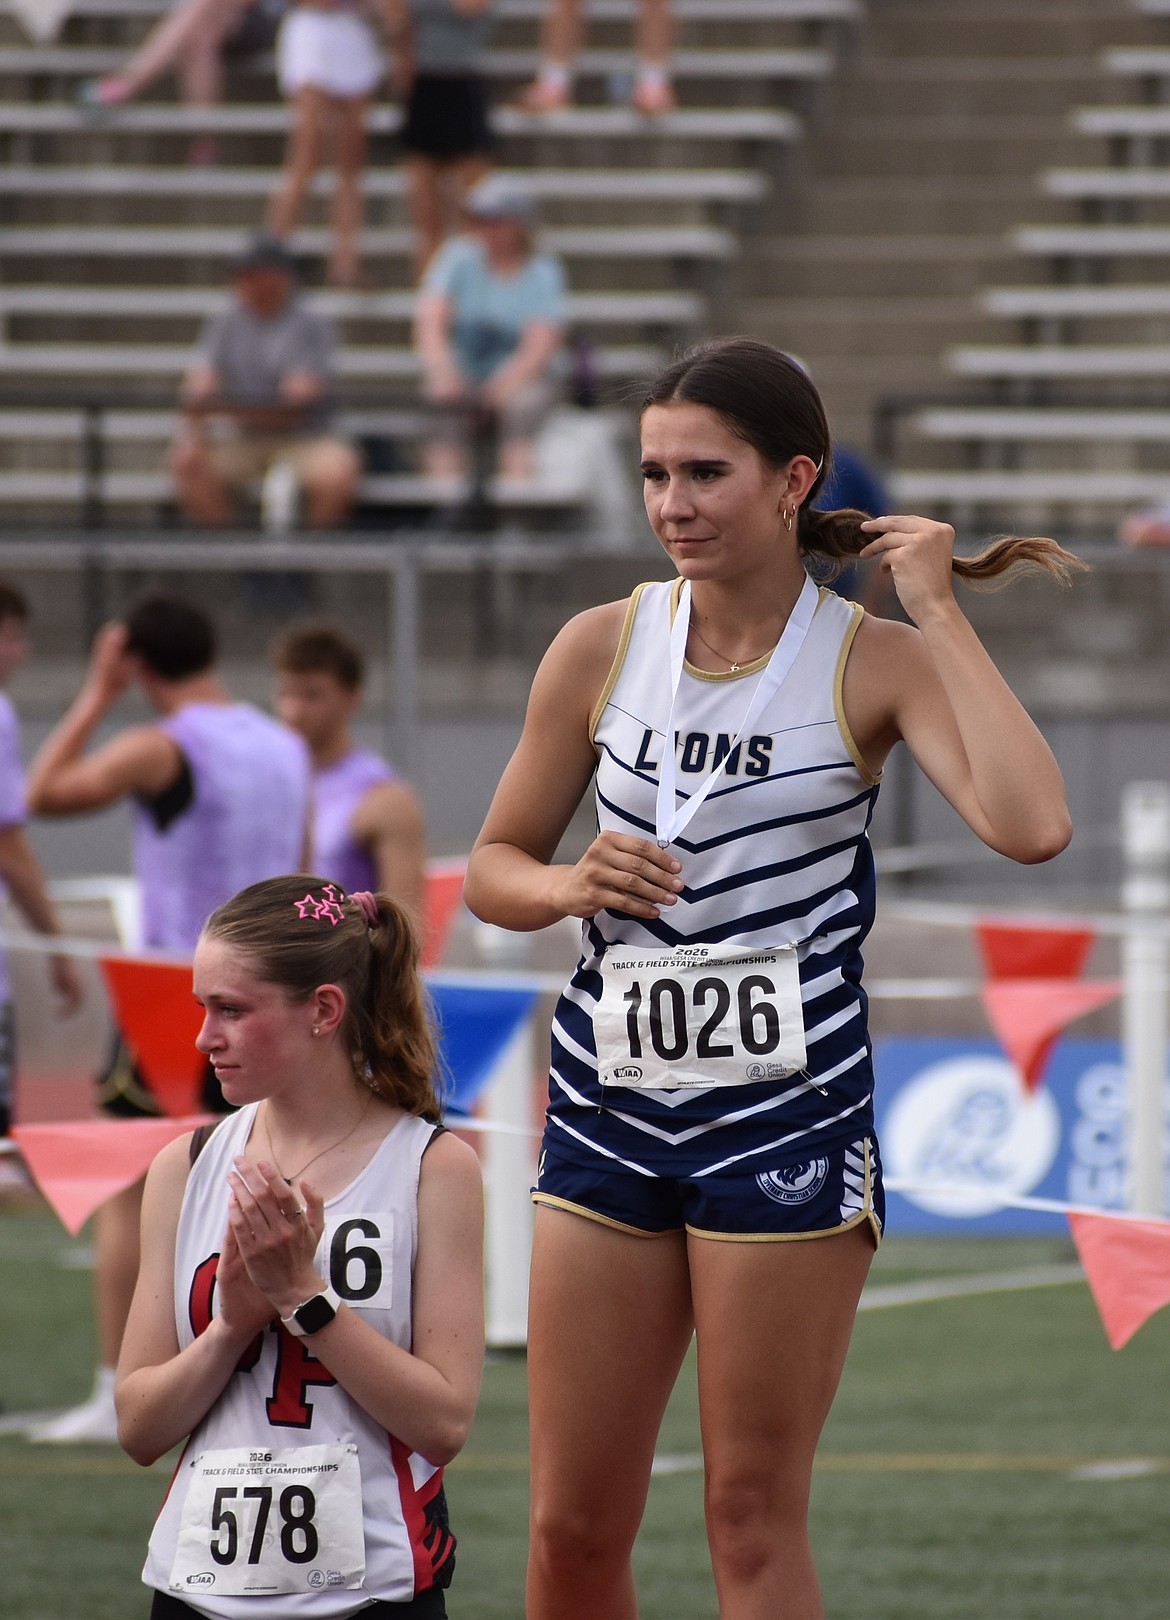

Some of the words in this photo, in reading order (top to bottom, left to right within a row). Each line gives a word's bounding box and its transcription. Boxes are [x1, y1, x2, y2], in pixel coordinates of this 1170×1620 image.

[634, 729, 773, 777] LONS
[611, 961, 636, 970] TRACK
[637, 960, 644, 969] &
[645, 960, 669, 968] FIELD
[669, 960, 697, 968] STATE
[699, 955, 777, 968] CHAMPIONSHIPS
[675, 948, 709, 957] 2026
[623, 974, 781, 1061] 1026
[329, 1218, 383, 1301] 6
[202, 1468, 221, 1476] TRACK
[227, 1467, 245, 1476] FIELD
[265, 1464, 339, 1475] CHAMPIONSHIPS
[249, 1452, 272, 1462] 2026
[210, 1484, 319, 1566] 578
